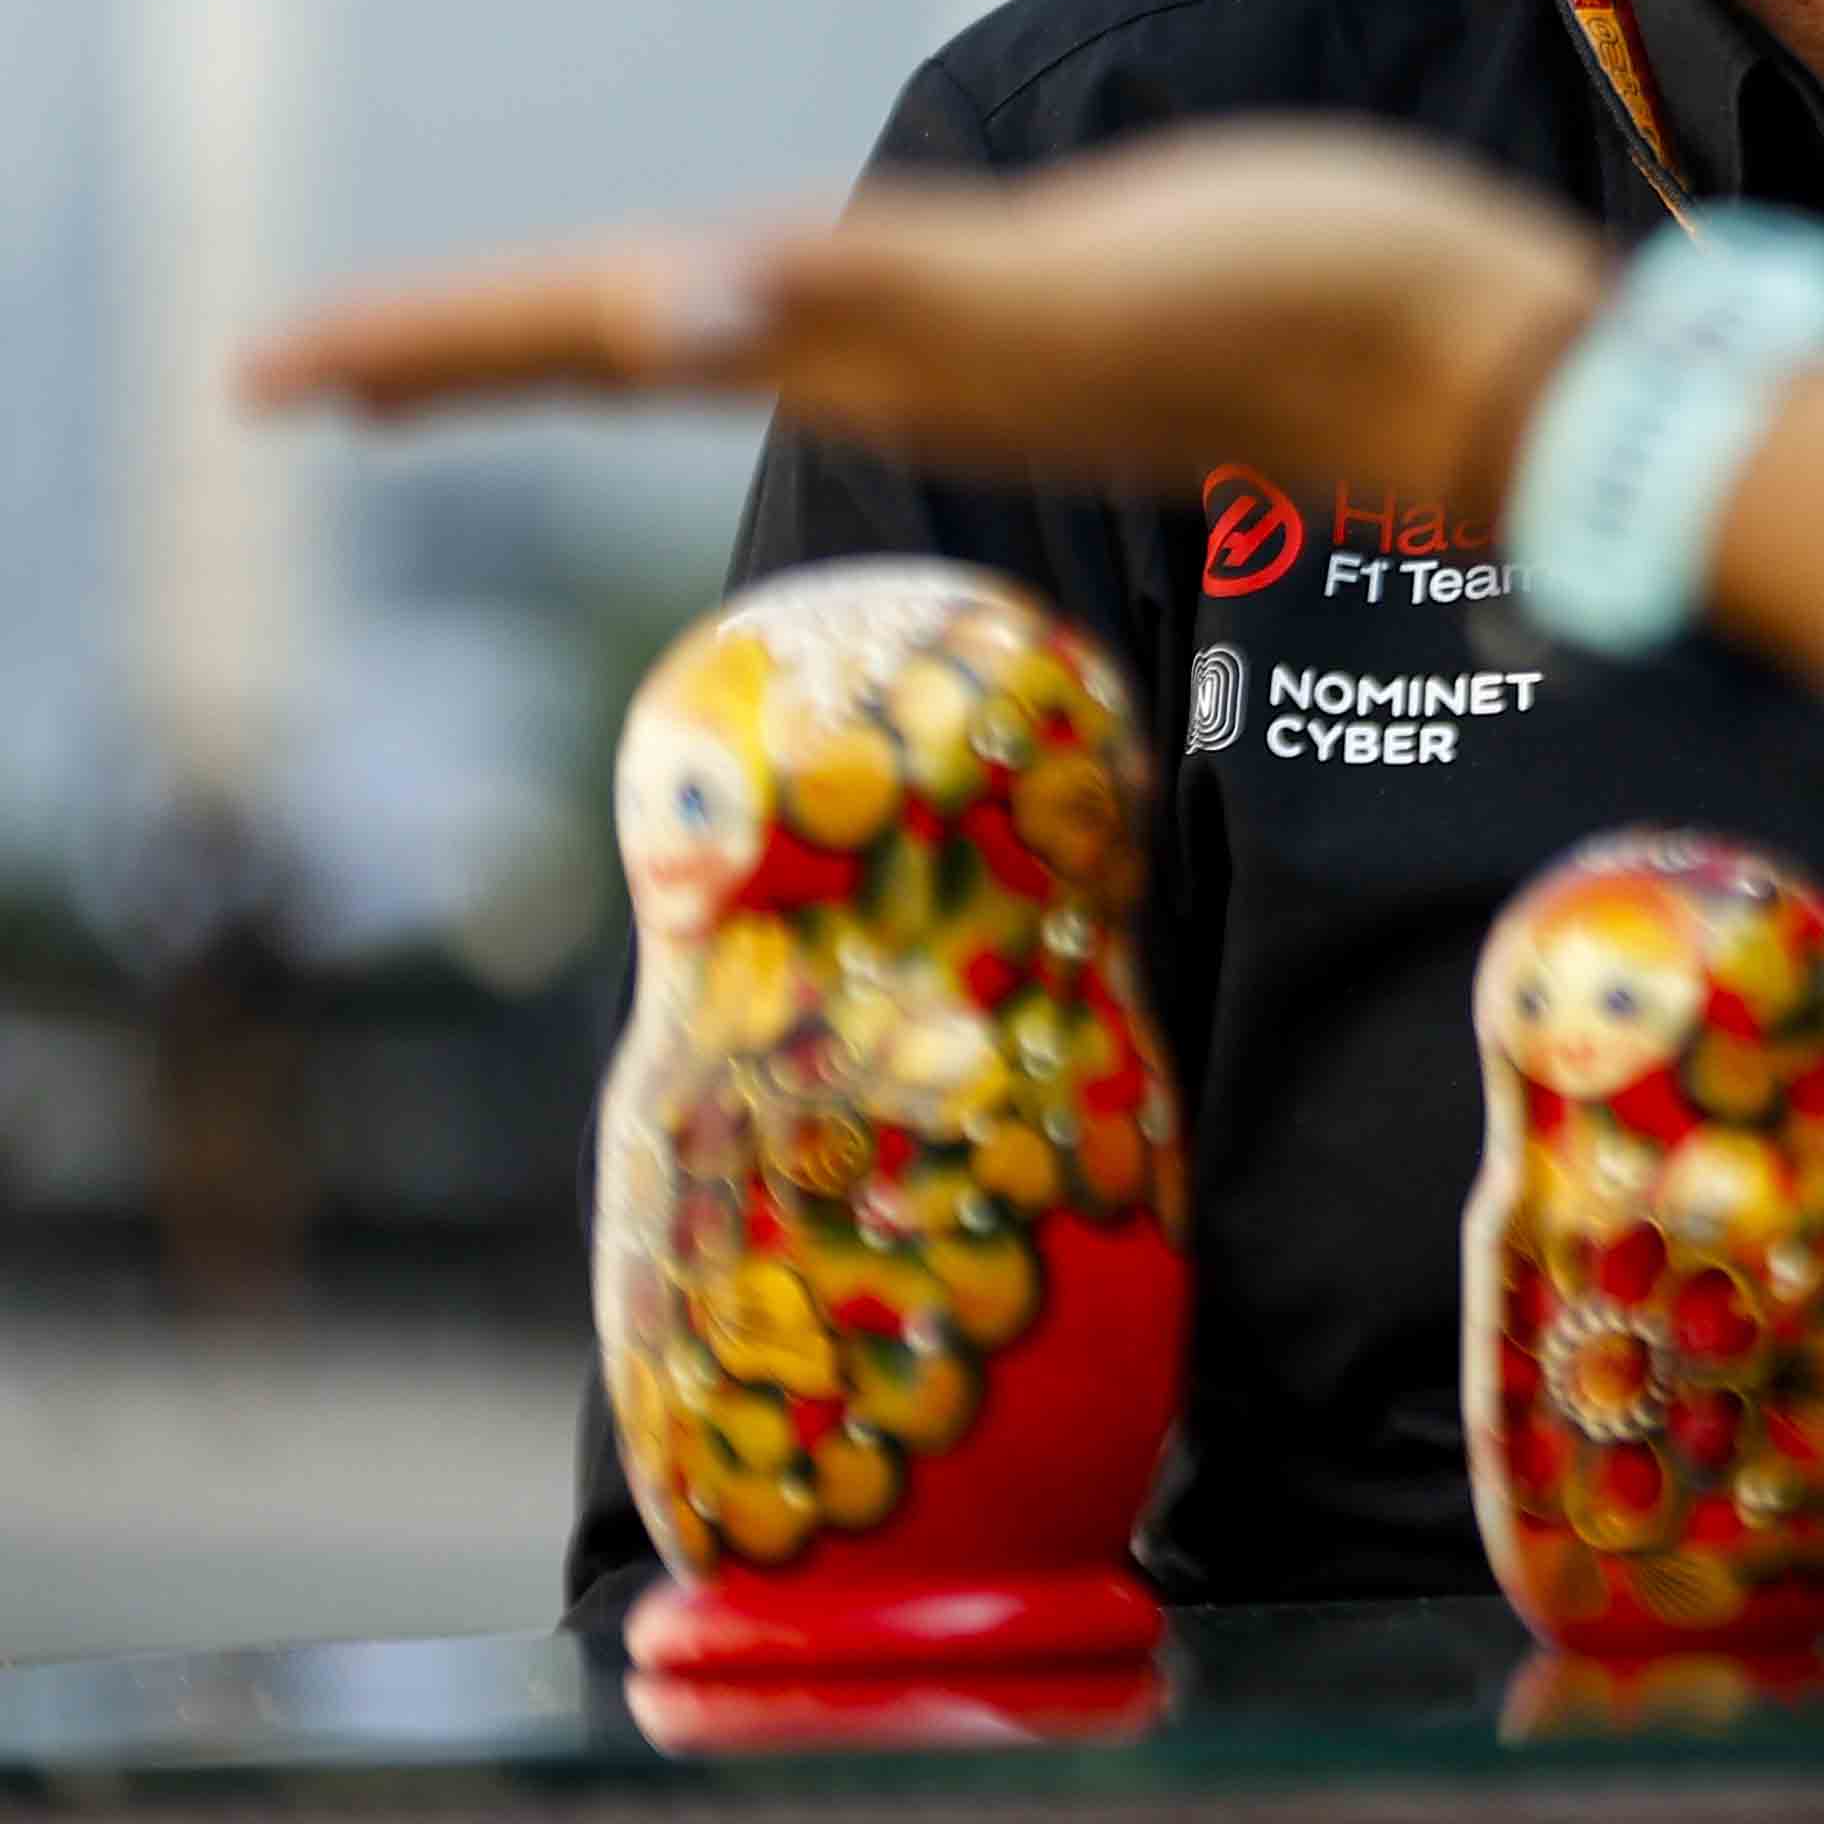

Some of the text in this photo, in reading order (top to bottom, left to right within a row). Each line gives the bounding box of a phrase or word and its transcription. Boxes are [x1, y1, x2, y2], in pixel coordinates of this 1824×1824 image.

[1331, 478, 1490, 557] Ha
[1323, 550, 1389, 605] F1
[1269, 664, 1543, 718] NOMINET
[1266, 714, 1460, 766] CYBER
